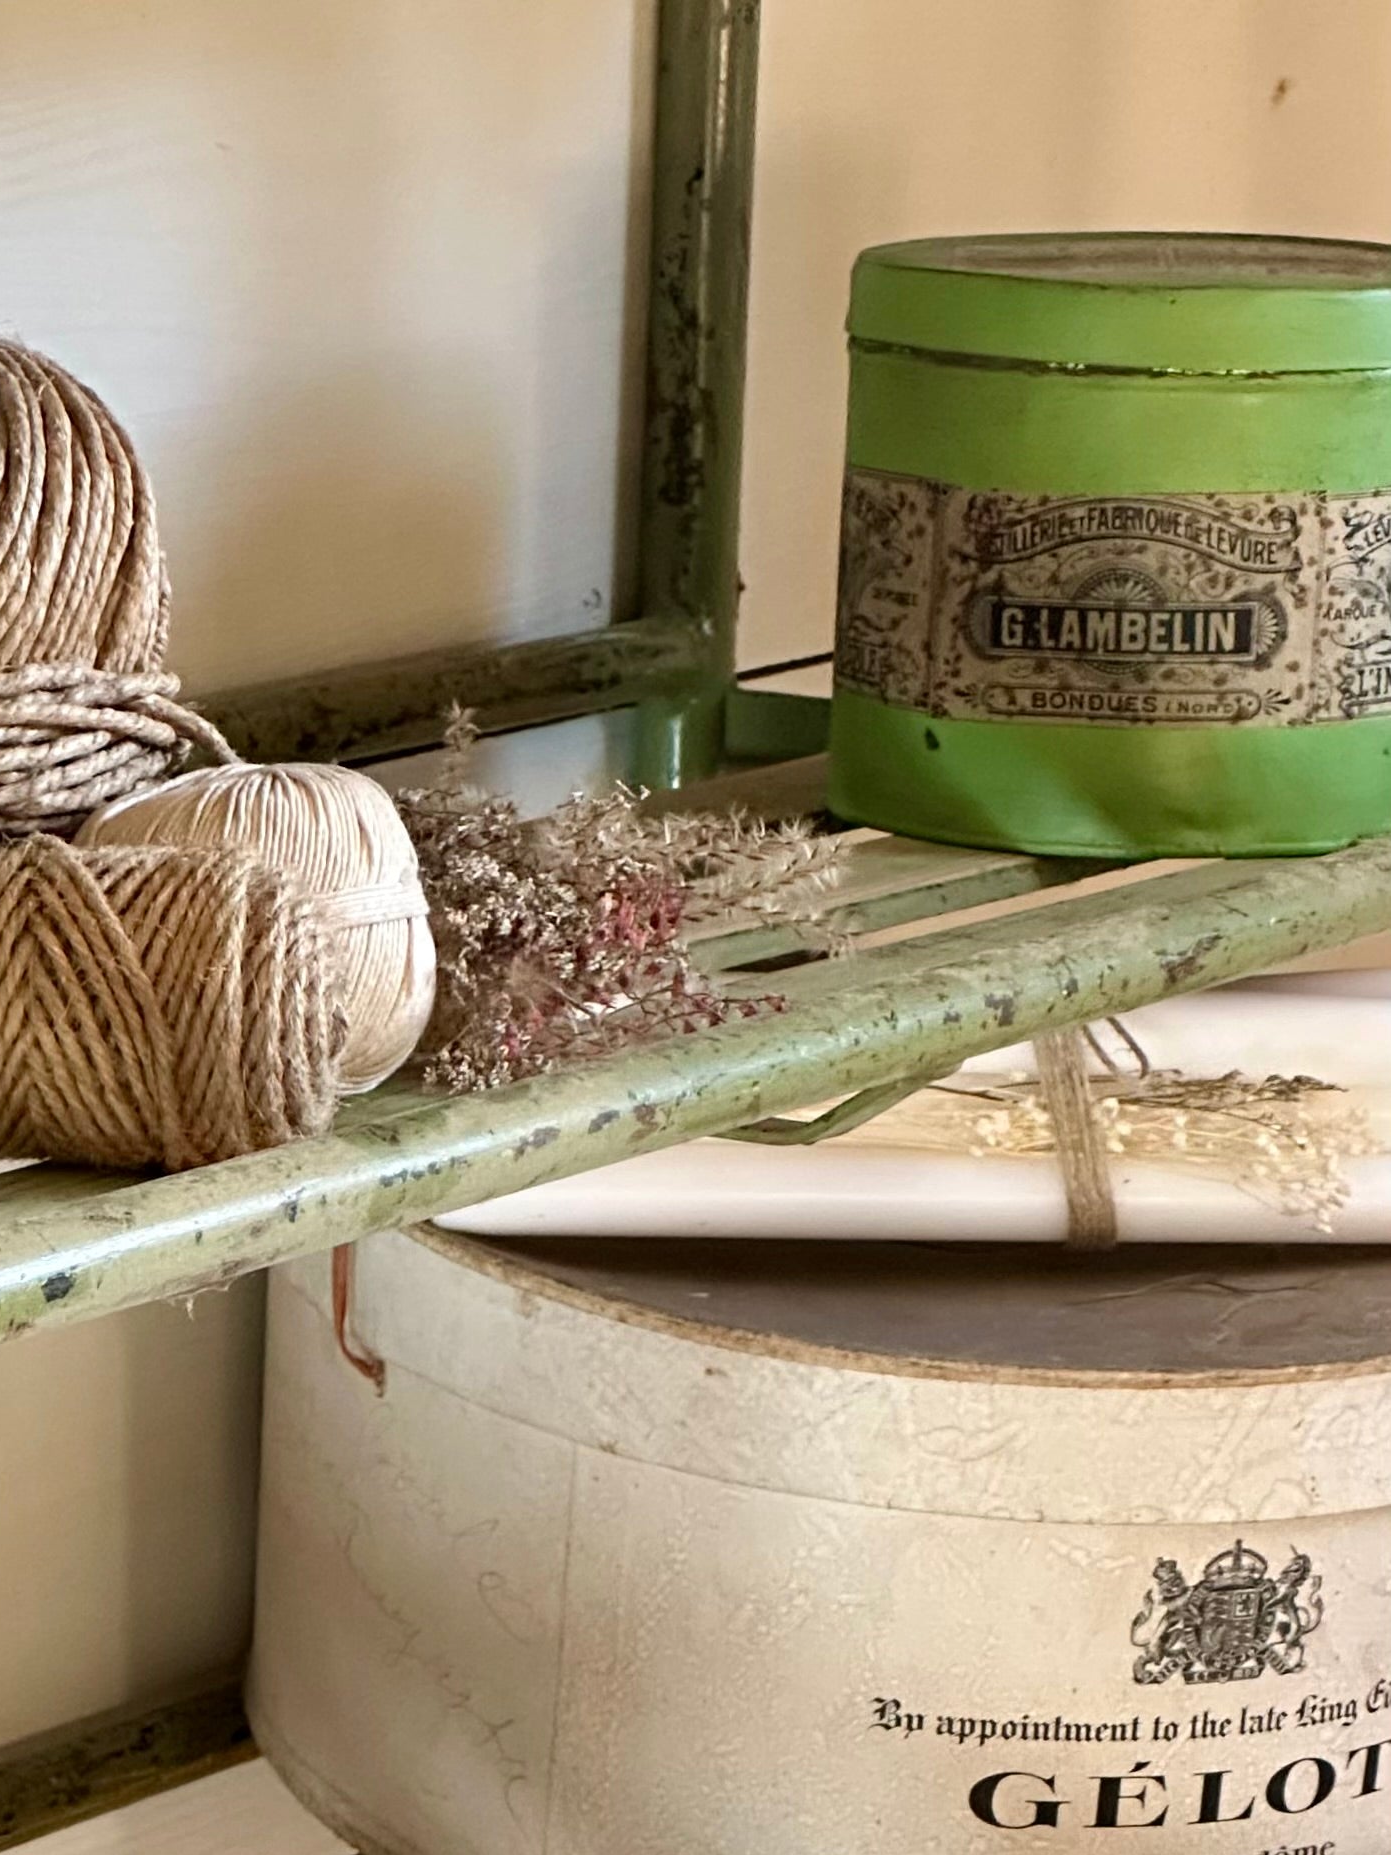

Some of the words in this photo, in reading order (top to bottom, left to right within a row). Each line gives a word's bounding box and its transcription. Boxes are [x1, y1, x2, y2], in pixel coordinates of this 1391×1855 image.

[1207, 523, 1278, 565] LEVURE
[1031, 692, 1158, 713] BONDUES
[868, 1697, 927, 1739] By
[935, 1713, 1140, 1747] appointment
[1152, 1716, 1179, 1742] to
[1189, 1711, 1232, 1740] the
[1239, 1706, 1288, 1735] late
[1295, 1694, 1358, 1727] King
[968, 1739, 1391, 1830] GÉLOT
